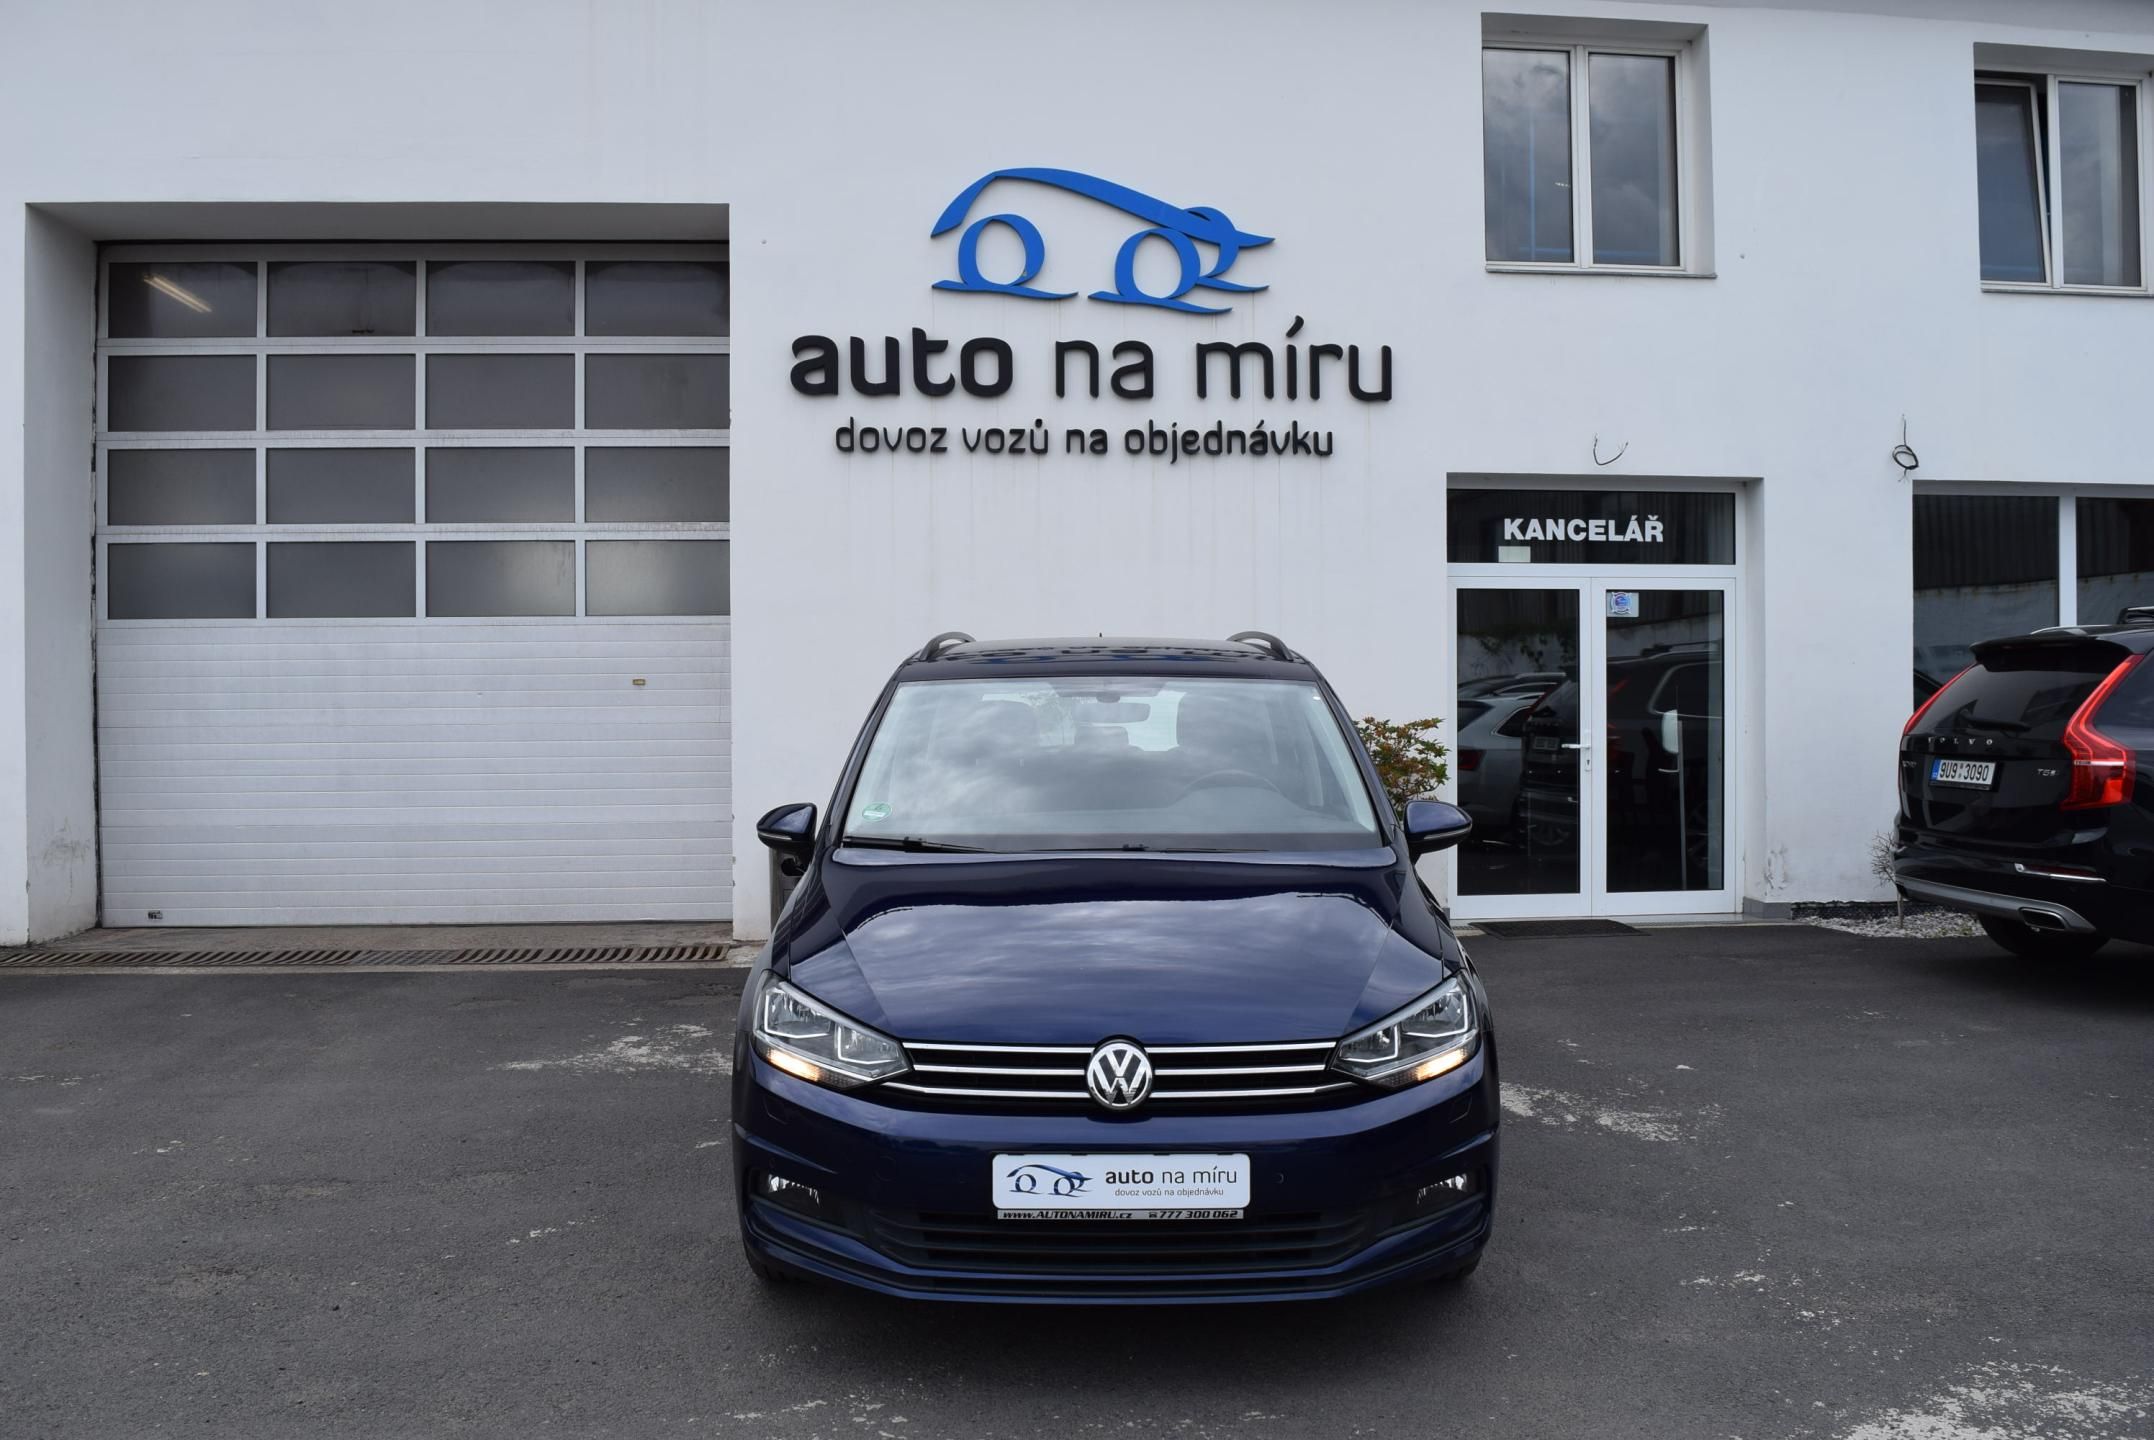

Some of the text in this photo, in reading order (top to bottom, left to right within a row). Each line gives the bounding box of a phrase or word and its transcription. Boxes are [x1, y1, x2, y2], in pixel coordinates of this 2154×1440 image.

[790, 315, 1393, 403] auto na míru
[836, 417, 1334, 464] dovoz vozů na objednávku
[1503, 514, 1664, 543] KANCELÁŘ
[1939, 762, 1990, 782] 9U9 3090
[1105, 1165, 1237, 1184] auto na míru
[1114, 1188, 1224, 1198] dovoz vozů na objednávku
[1002, 1210, 1239, 1219] www.AUTONAMIRU.cz 777 300 062
